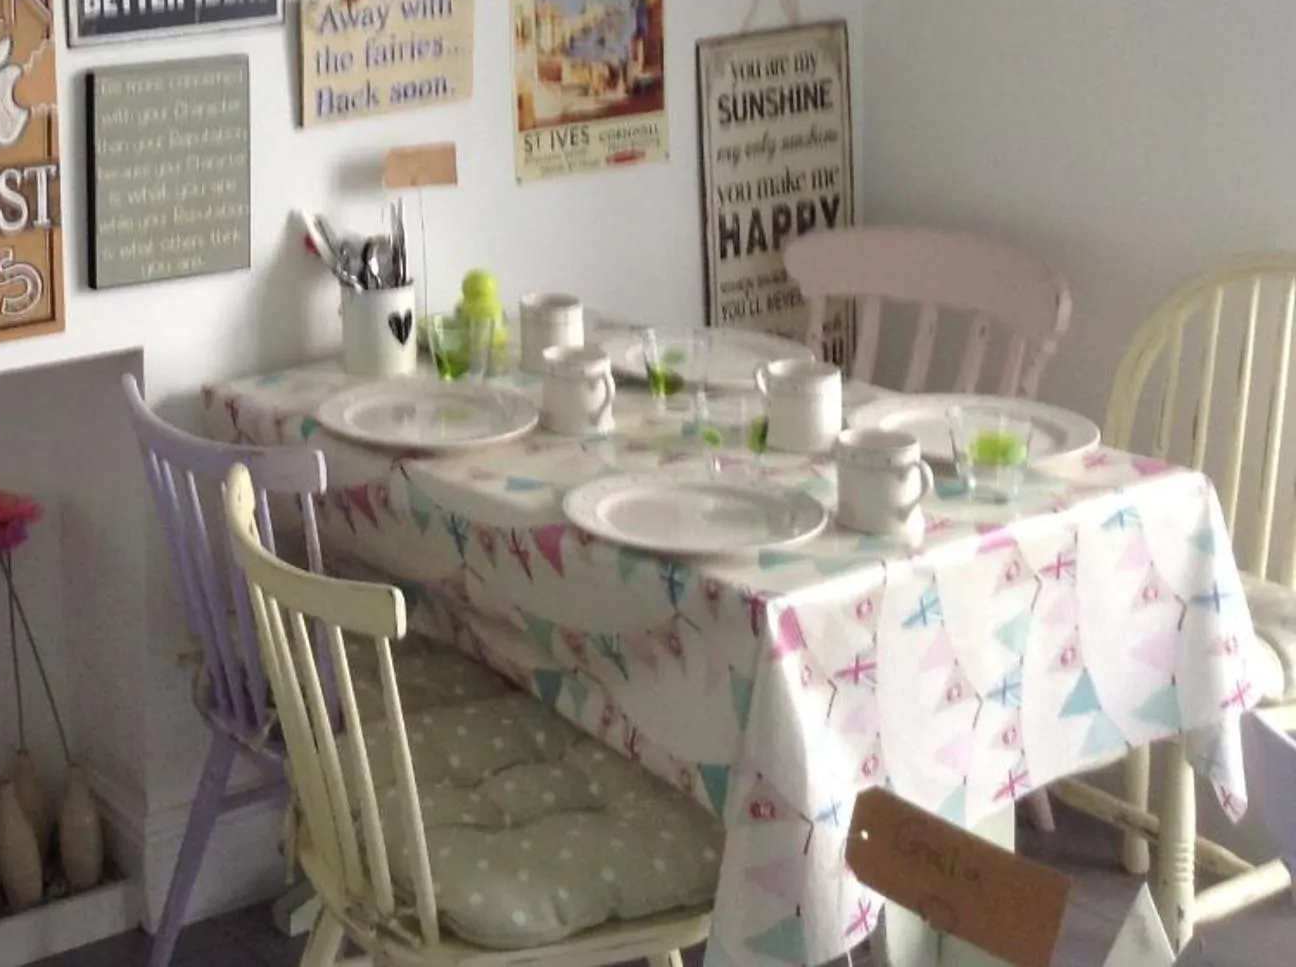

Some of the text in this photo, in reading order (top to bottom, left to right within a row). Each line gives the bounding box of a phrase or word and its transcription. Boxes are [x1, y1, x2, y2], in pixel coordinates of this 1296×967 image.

[318, 3, 391, 35] Away
[314, 45, 355, 76] the
[764, 57, 788, 77] are
[793, 50, 818, 75] my
[315, 75, 456, 119] Back soon.
[717, 79, 833, 125] SUNSHINE
[523, 131, 542, 155] ST
[549, 123, 591, 151] IVES
[745, 131, 778, 158] only
[716, 166, 840, 209] you make me
[717, 194, 841, 260] HAPPY
